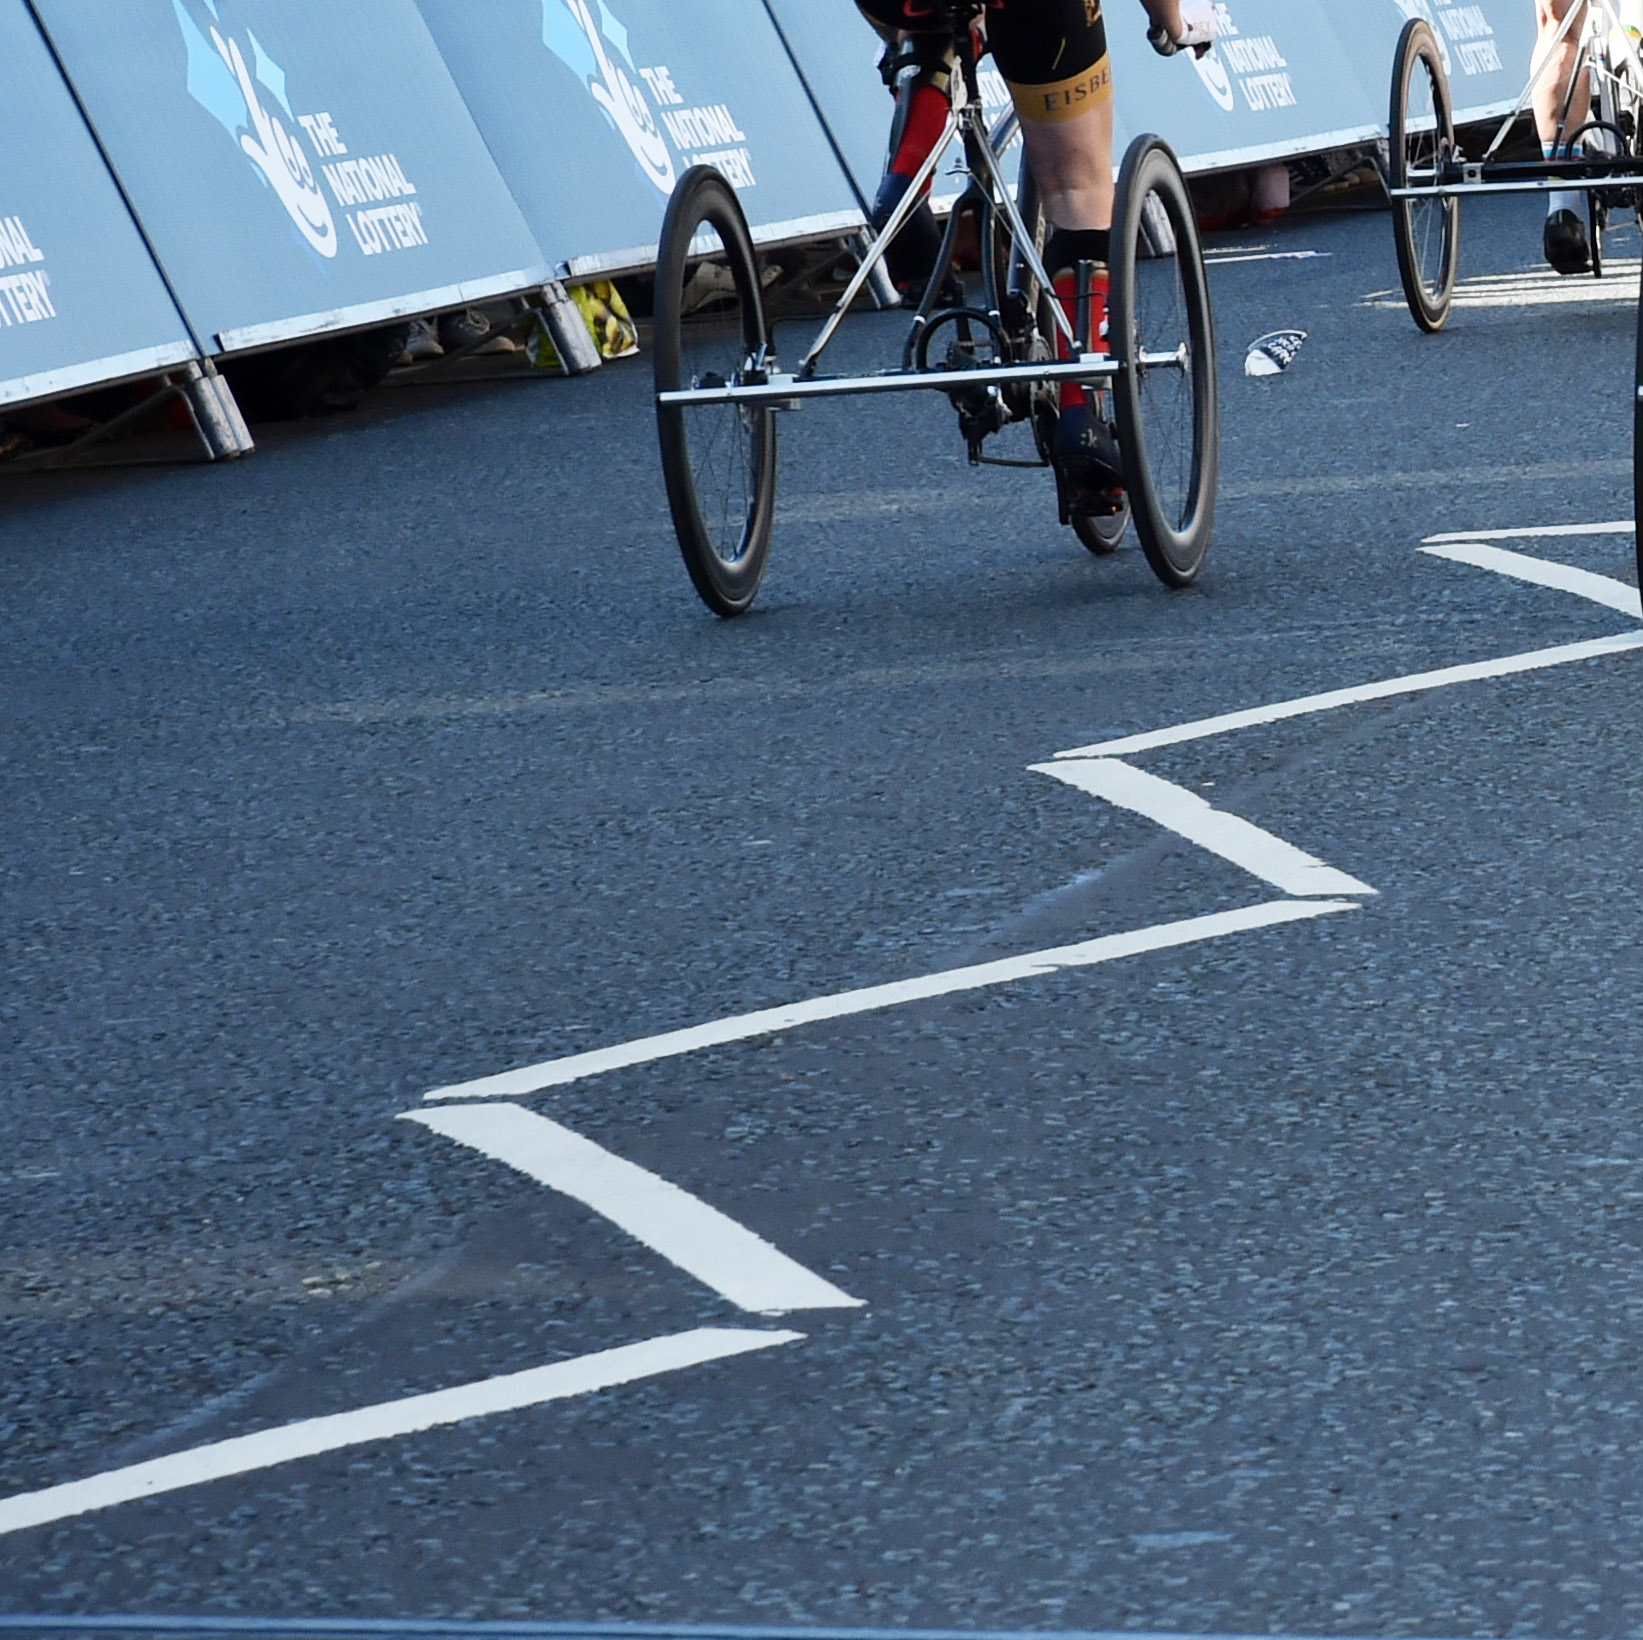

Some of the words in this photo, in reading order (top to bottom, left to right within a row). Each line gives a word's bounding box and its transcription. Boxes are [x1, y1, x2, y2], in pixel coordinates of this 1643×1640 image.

[1213, 2, 1239, 37] HE
[1221, 35, 1288, 75] NATIONAL
[639, 66, 684, 106] THE
[1239, 71, 1297, 112] LOTTERY
[297, 111, 349, 158] THE
[661, 103, 747, 151] NATIONAL
[320, 153, 417, 207] NATIONAL
[345, 200, 429, 256] LOTTERY
